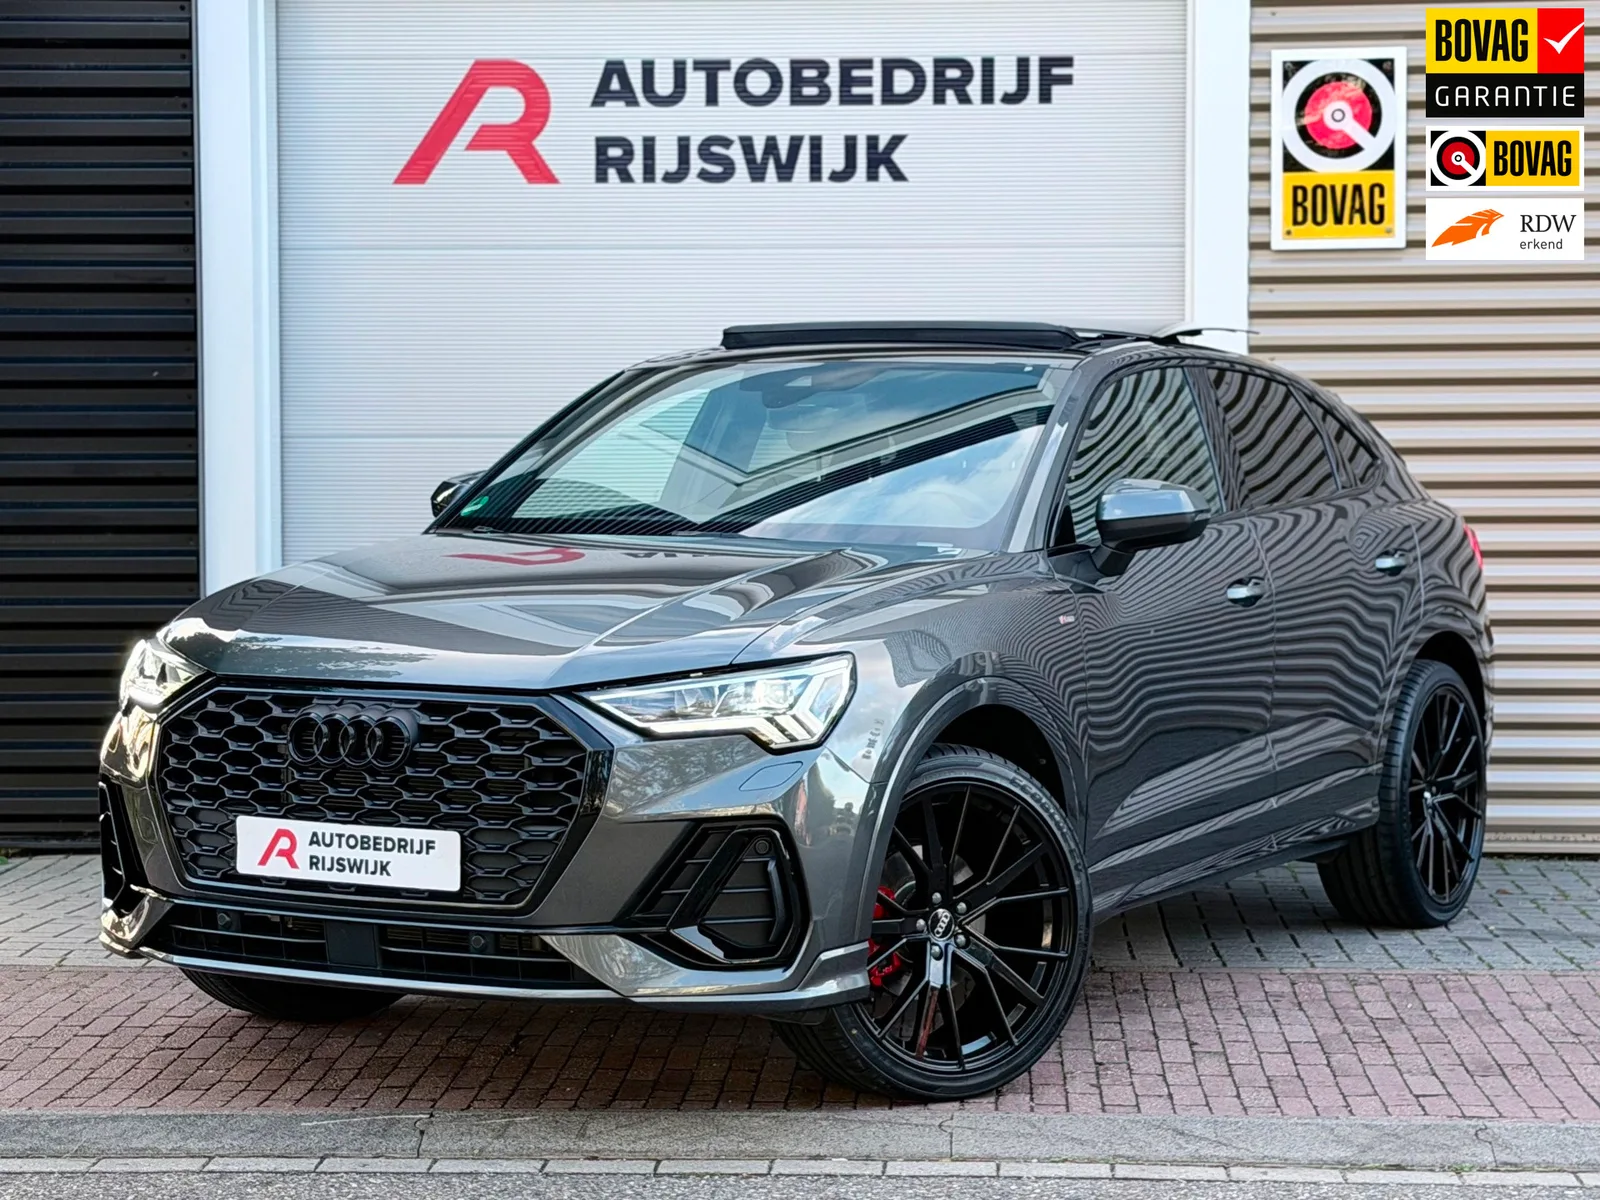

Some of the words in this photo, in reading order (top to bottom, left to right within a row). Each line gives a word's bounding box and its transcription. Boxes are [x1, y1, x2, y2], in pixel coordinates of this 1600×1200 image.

[590, 56, 1075, 108] AUTOBEDRIJF
[593, 134, 909, 184] RIJSWIJK
[1291, 182, 1386, 227] BOVAG
[308, 831, 436, 855] AUTOBEDRIJF
[309, 855, 391, 877] RIJSWIJK
